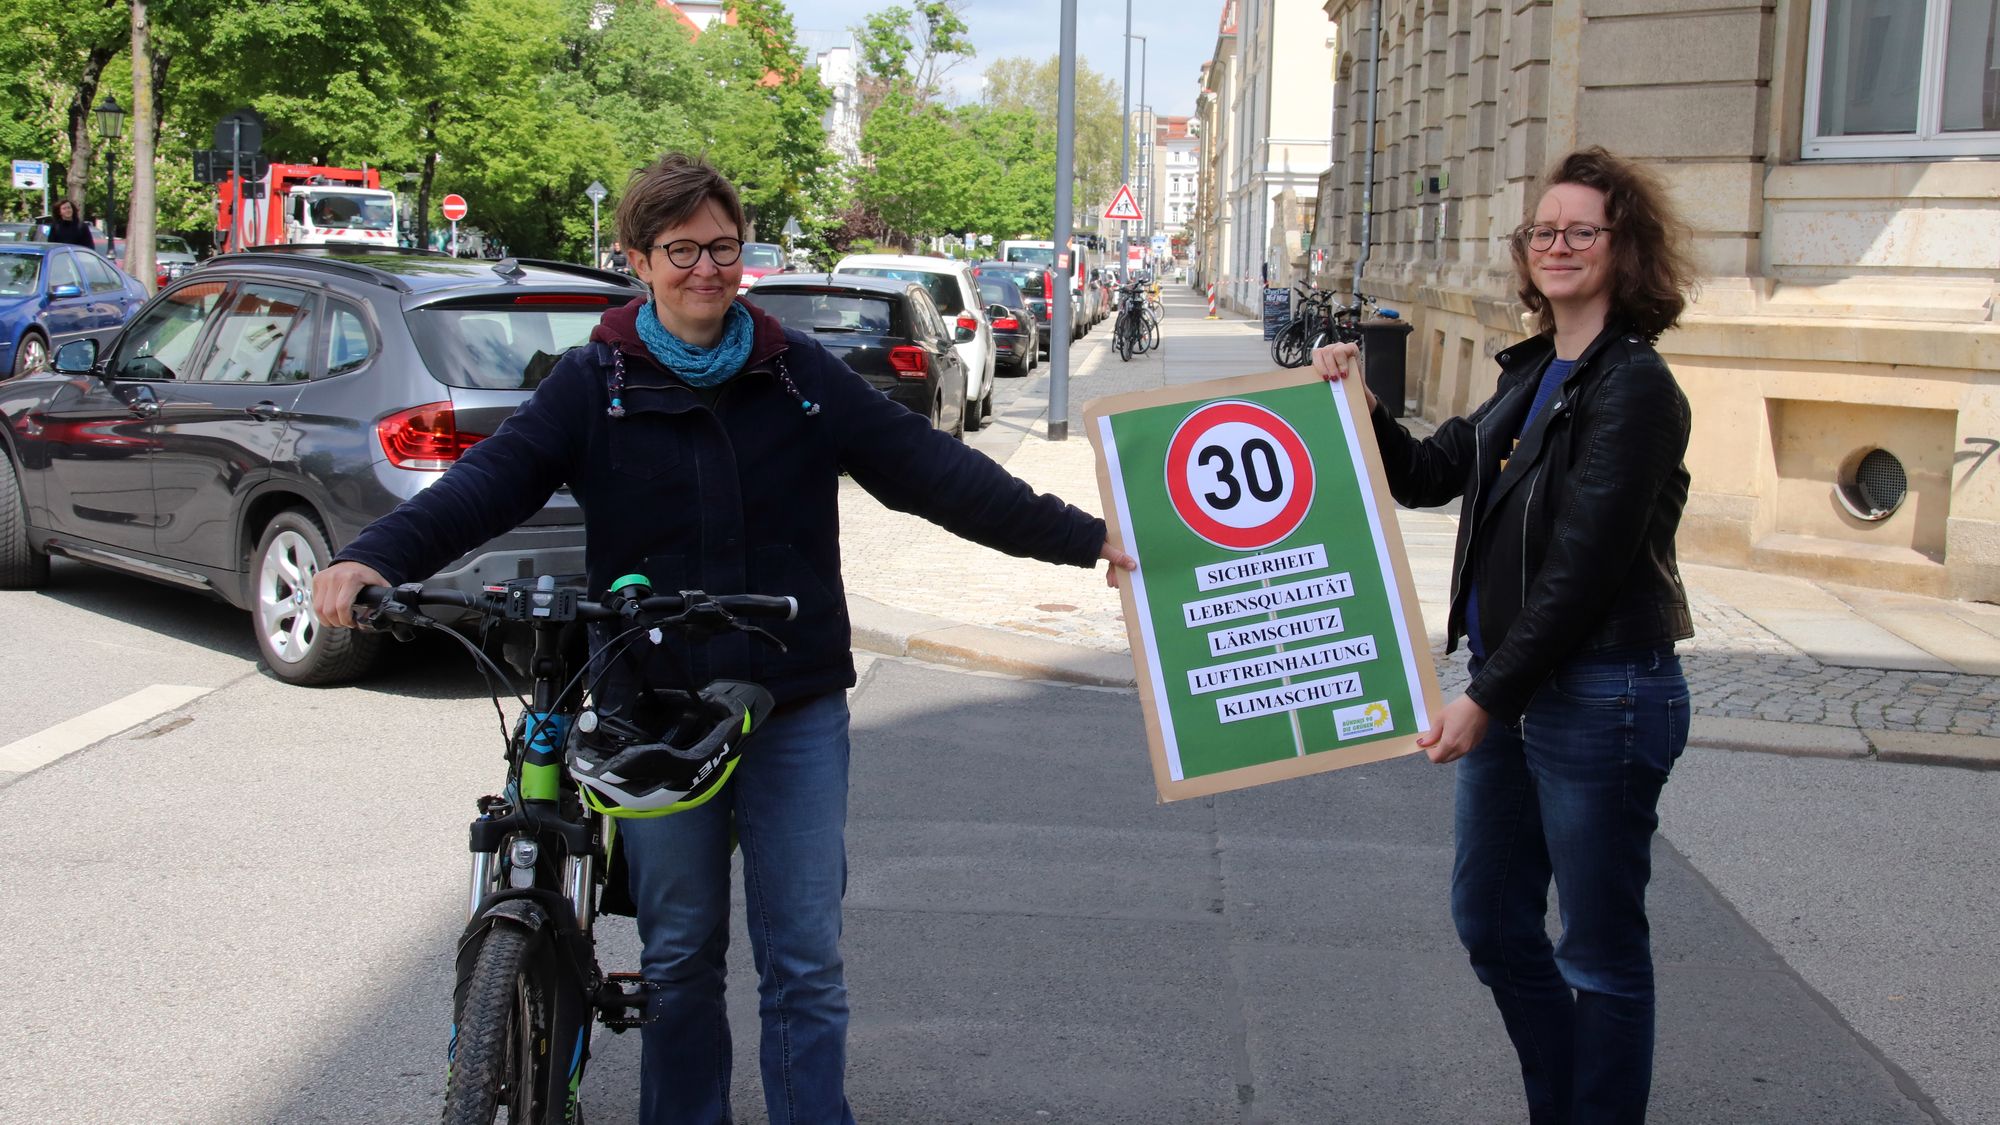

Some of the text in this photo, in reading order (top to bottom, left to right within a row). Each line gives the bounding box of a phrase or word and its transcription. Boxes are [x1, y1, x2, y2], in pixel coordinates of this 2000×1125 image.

[1198, 438, 1284, 511] 30
[1207, 551, 1316, 584] SICHERHEIT
[1189, 578, 1348, 622] LEBENSQUALITÄT
[1214, 614, 1339, 651] LÄRMSCHUTZ
[1195, 642, 1371, 689] LUFTREINHALTUNG
[1223, 679, 1357, 717] KLIMASCHUTZ
[689, 742, 730, 790] MET
